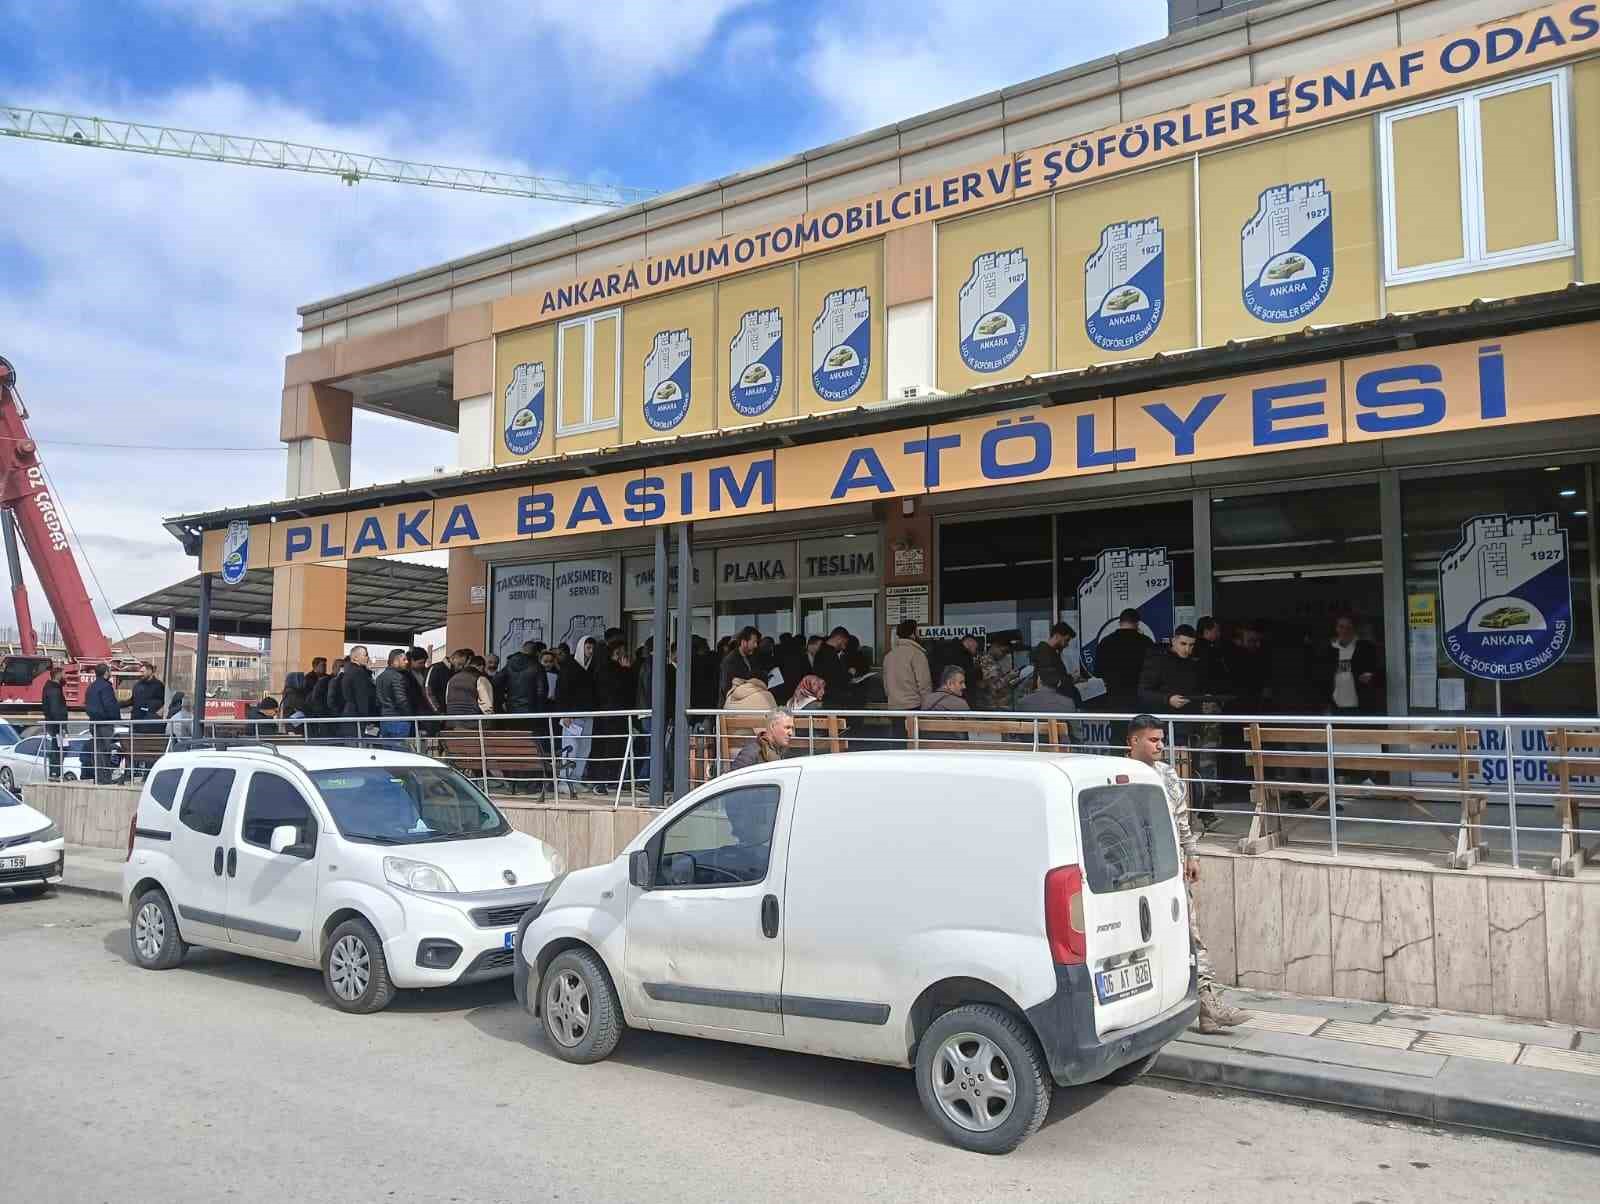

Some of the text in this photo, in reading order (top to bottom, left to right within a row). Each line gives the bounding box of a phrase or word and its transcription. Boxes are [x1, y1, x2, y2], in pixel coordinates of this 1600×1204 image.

[541, 269, 639, 314] ANKARA
[987, 158, 1032, 194] VE
[1043, 98, 1259, 188] ŞÖFÖRLER
[1269, 50, 1424, 120] ESNAF
[1306, 208, 1327, 220] 1927
[1142, 245, 1160, 255] 1927
[1269, 283, 1307, 297] ANKARA
[1108, 313, 1141, 327] ANKARA
[980, 337, 1008, 351] ANKARA
[285, 503, 481, 561] PLAKA
[516, 459, 774, 536] BASIM
[830, 345, 1507, 499] ATÖLYESİ
[1530, 550, 1561, 561] 1927
[723, 559, 785, 582] PLAKA
[1146, 578, 1168, 588] 1927
[1458, 651, 1473, 666] VE
[1525, 648, 1553, 670] ESNAF
[1550, 619, 1568, 649] ODASI
[1481, 634, 1534, 647] ANKARA
[1104, 973, 1114, 994] 06
